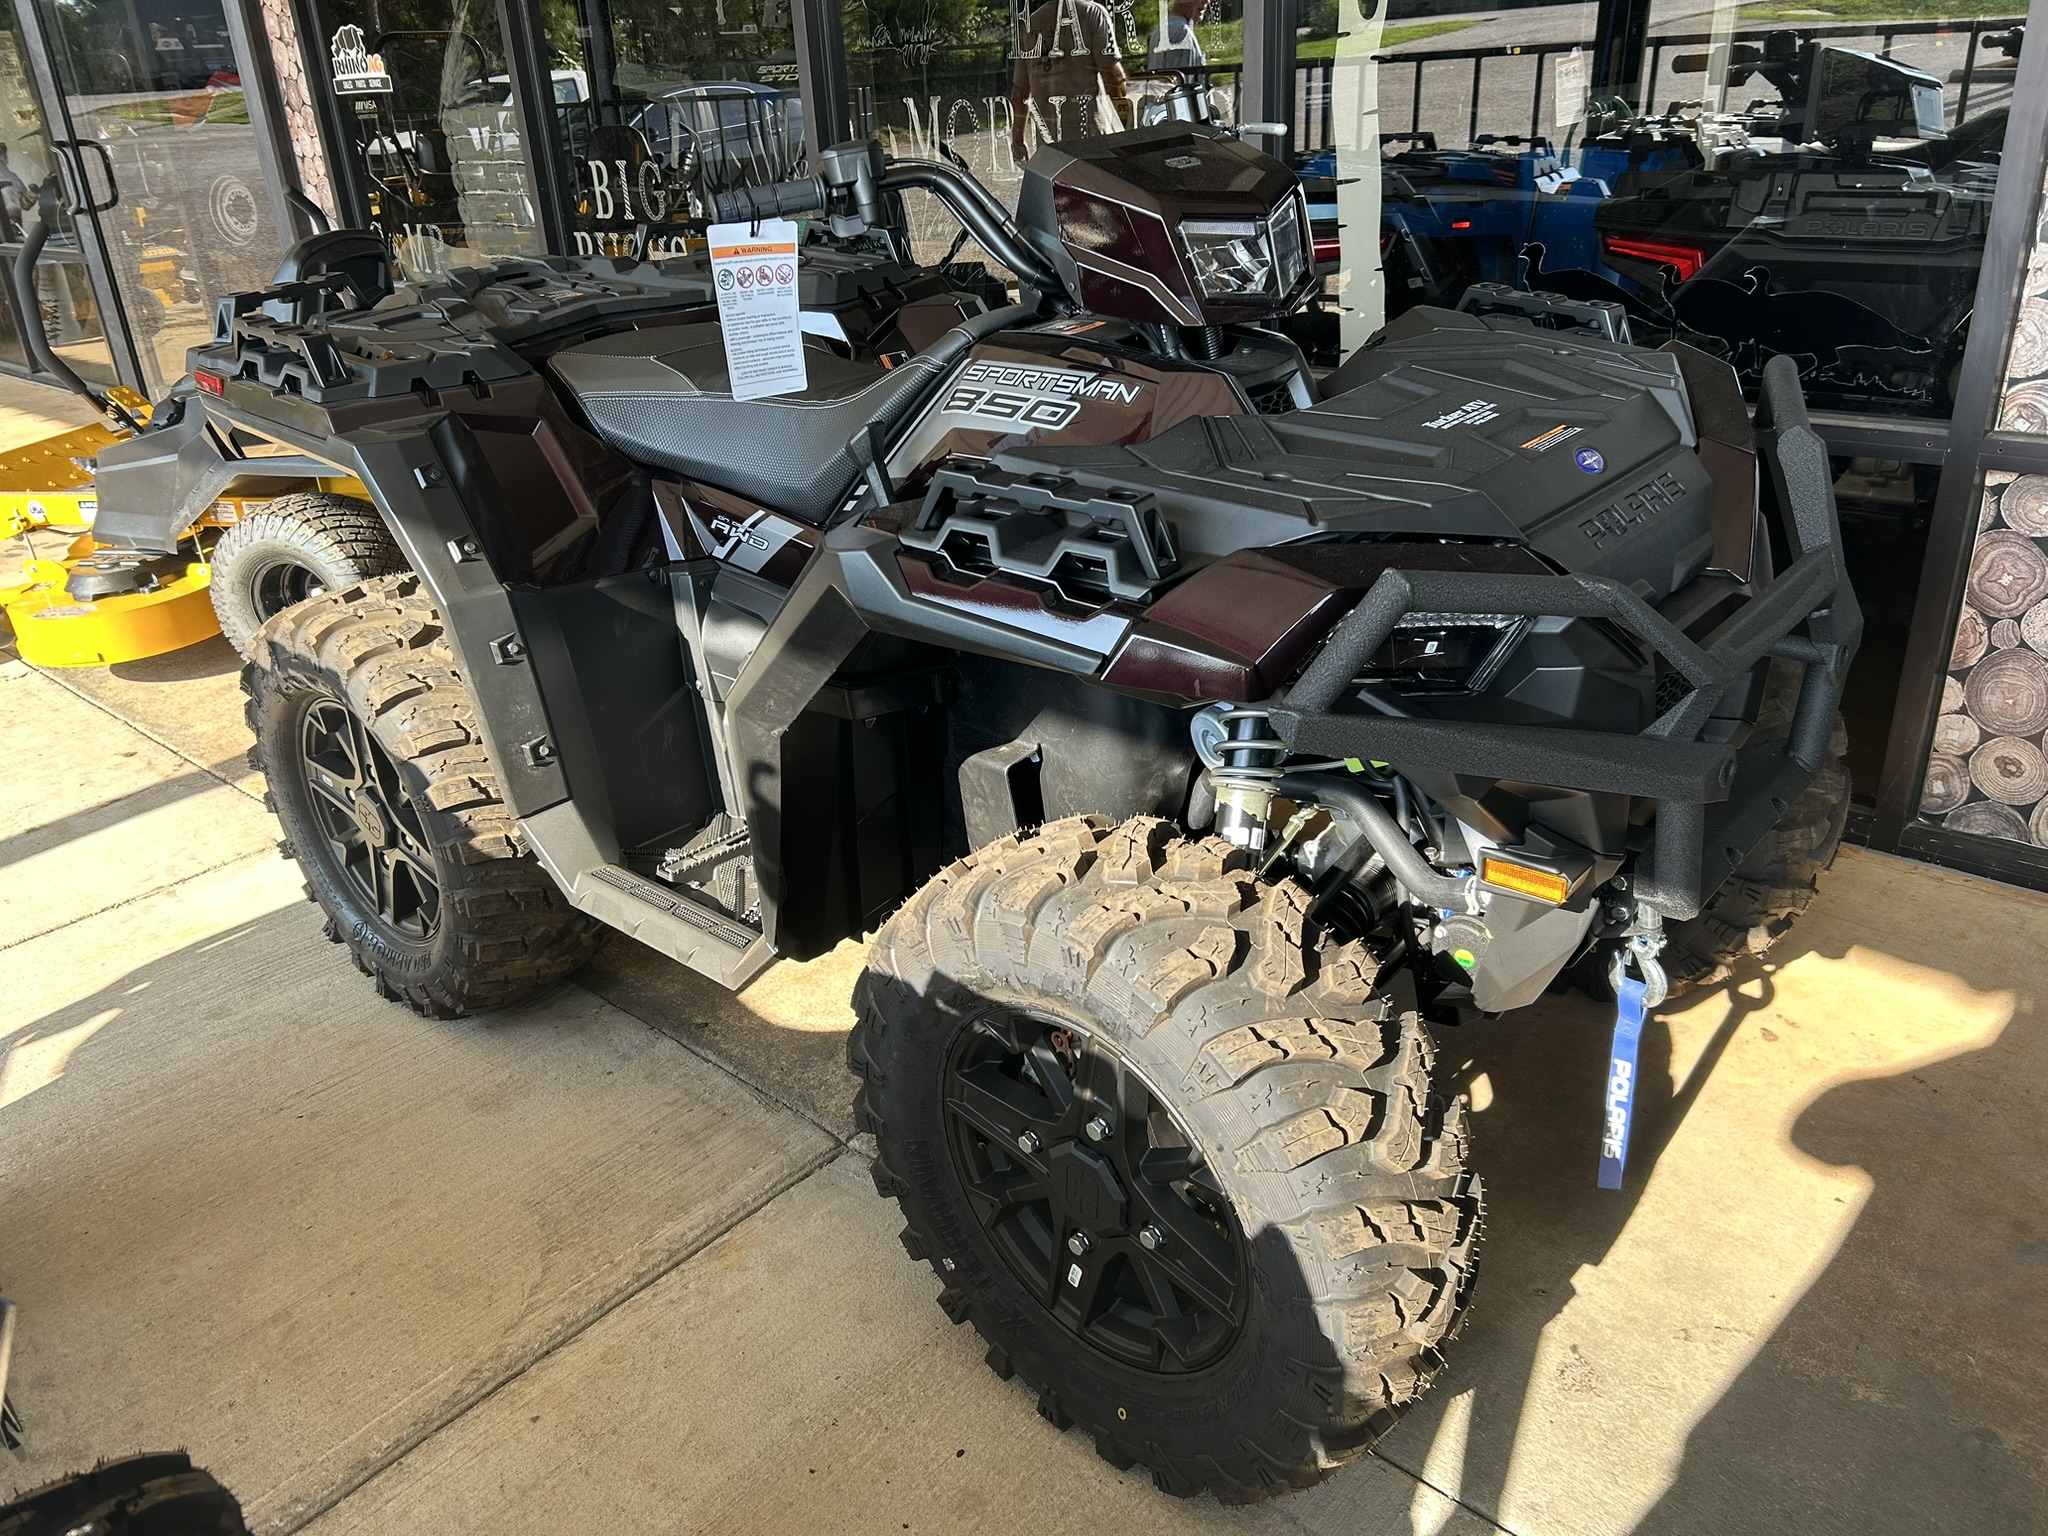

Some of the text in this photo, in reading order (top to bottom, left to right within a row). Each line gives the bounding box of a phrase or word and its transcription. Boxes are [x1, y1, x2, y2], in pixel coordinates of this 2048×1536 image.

[756, 64, 799, 74] SPORT
[587, 160, 667, 221] BIG
[1803, 220, 1928, 237] POLARIS
[741, 245, 773, 255] WARNING
[963, 363, 1144, 406] SPORTSMAN
[941, 386, 1081, 431] 850
[1421, 410, 1467, 429] Tucker
[1460, 399, 1489, 412] ATV
[1578, 471, 1687, 550] POLARIS
[710, 519, 769, 551] AWD
[1603, 1058, 1632, 1159] POLARIS
